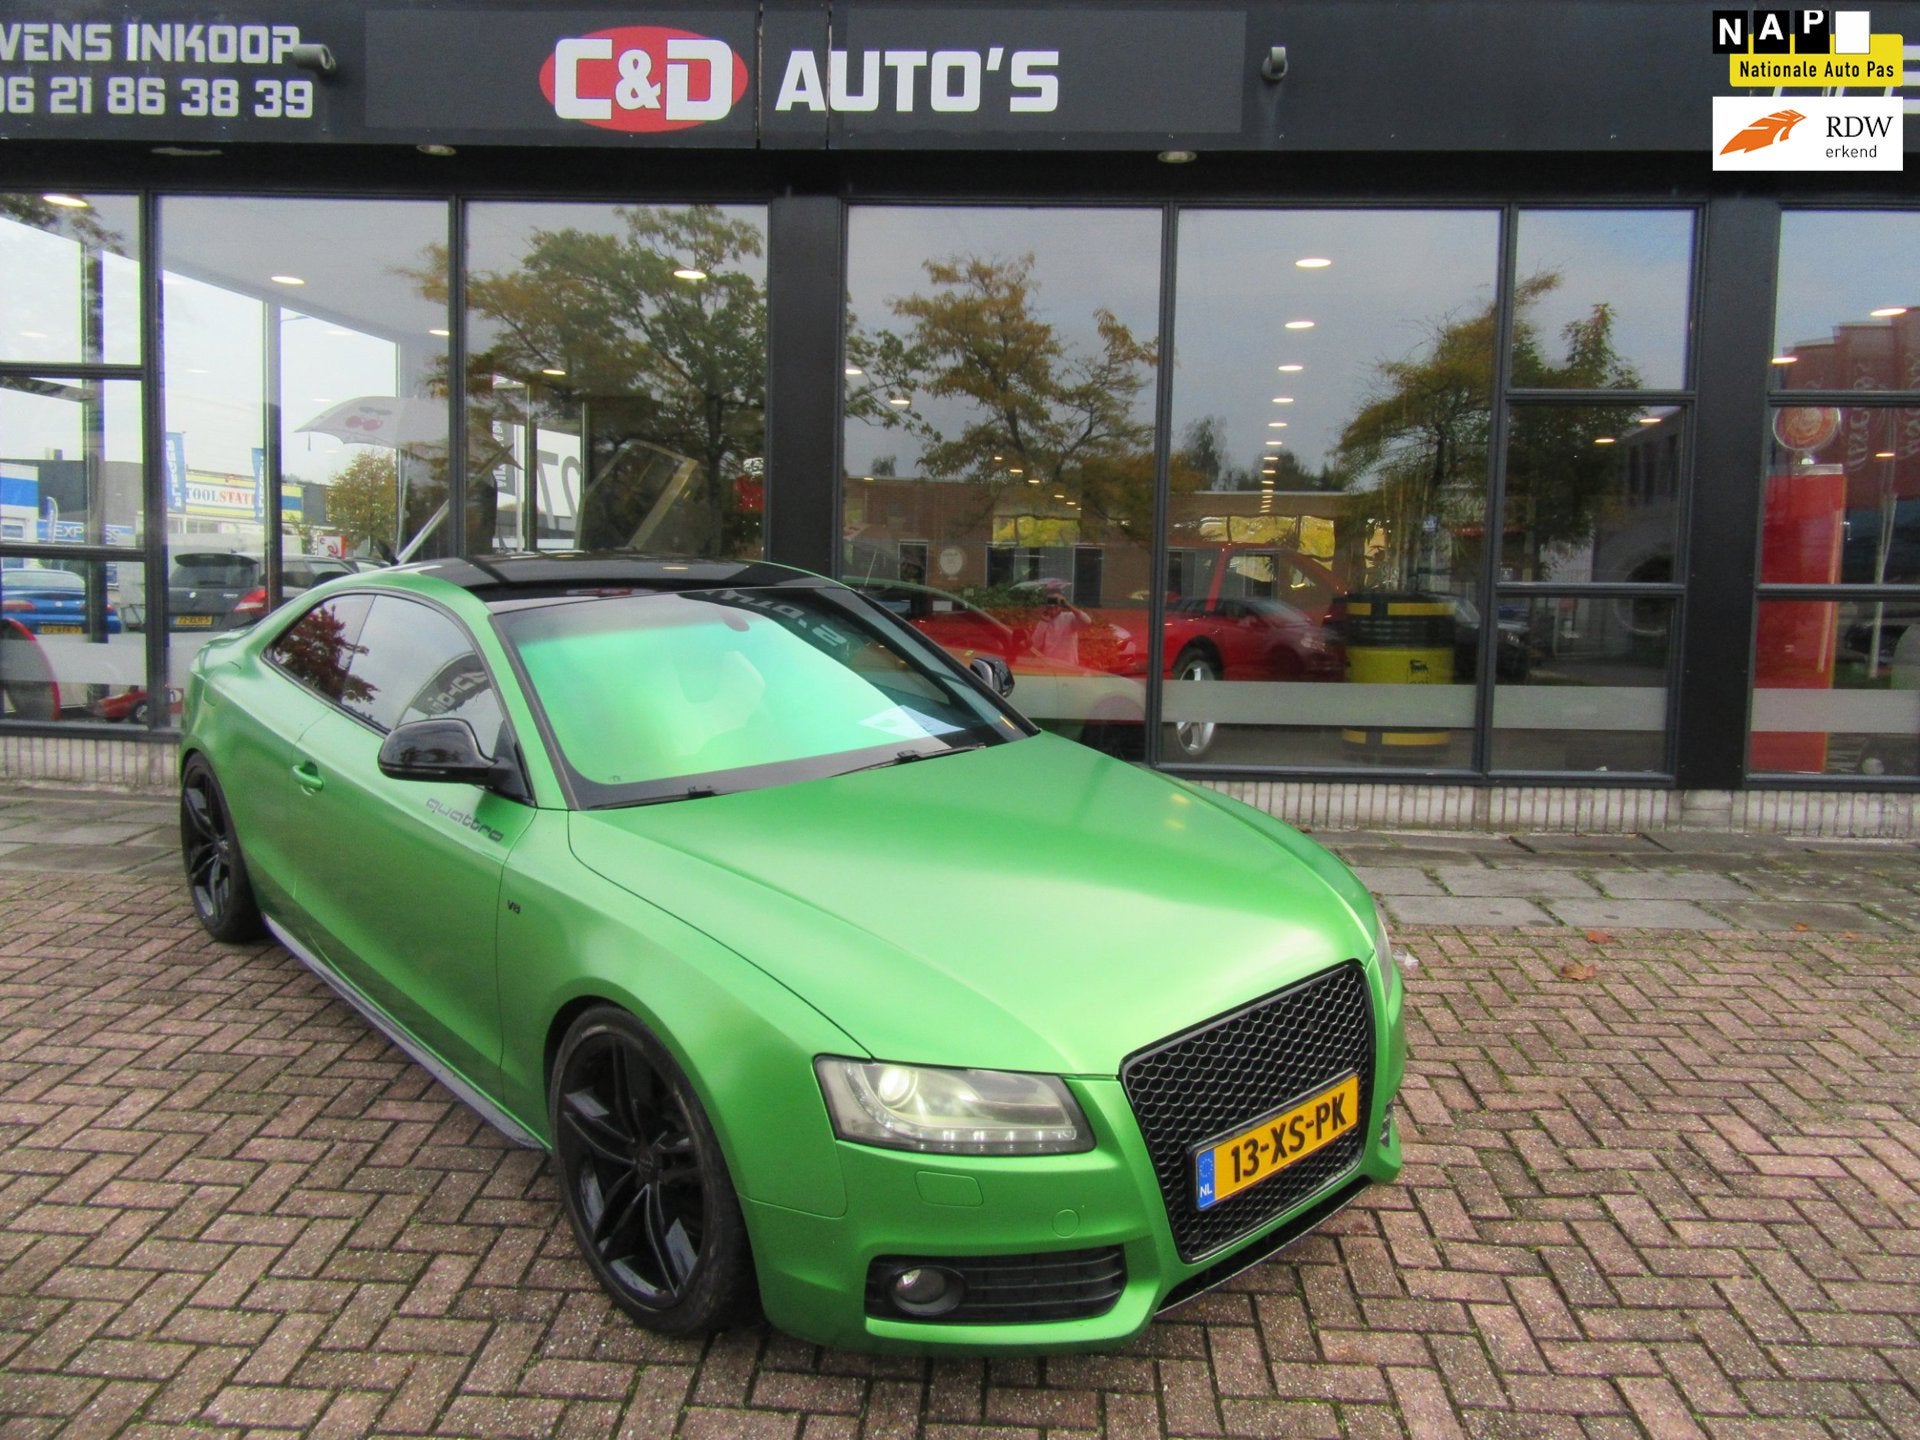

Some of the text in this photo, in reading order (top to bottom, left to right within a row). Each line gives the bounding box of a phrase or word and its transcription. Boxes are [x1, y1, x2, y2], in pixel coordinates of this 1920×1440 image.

[127, 24, 300, 64] INKOOP
[0, 76, 314, 118] 6 21 86 38 39
[554, 38, 1059, 121] C&D AUTO'S
[426, 798, 504, 842] quattro
[1199, 1092, 1347, 1199] NL 13-XS-PK
